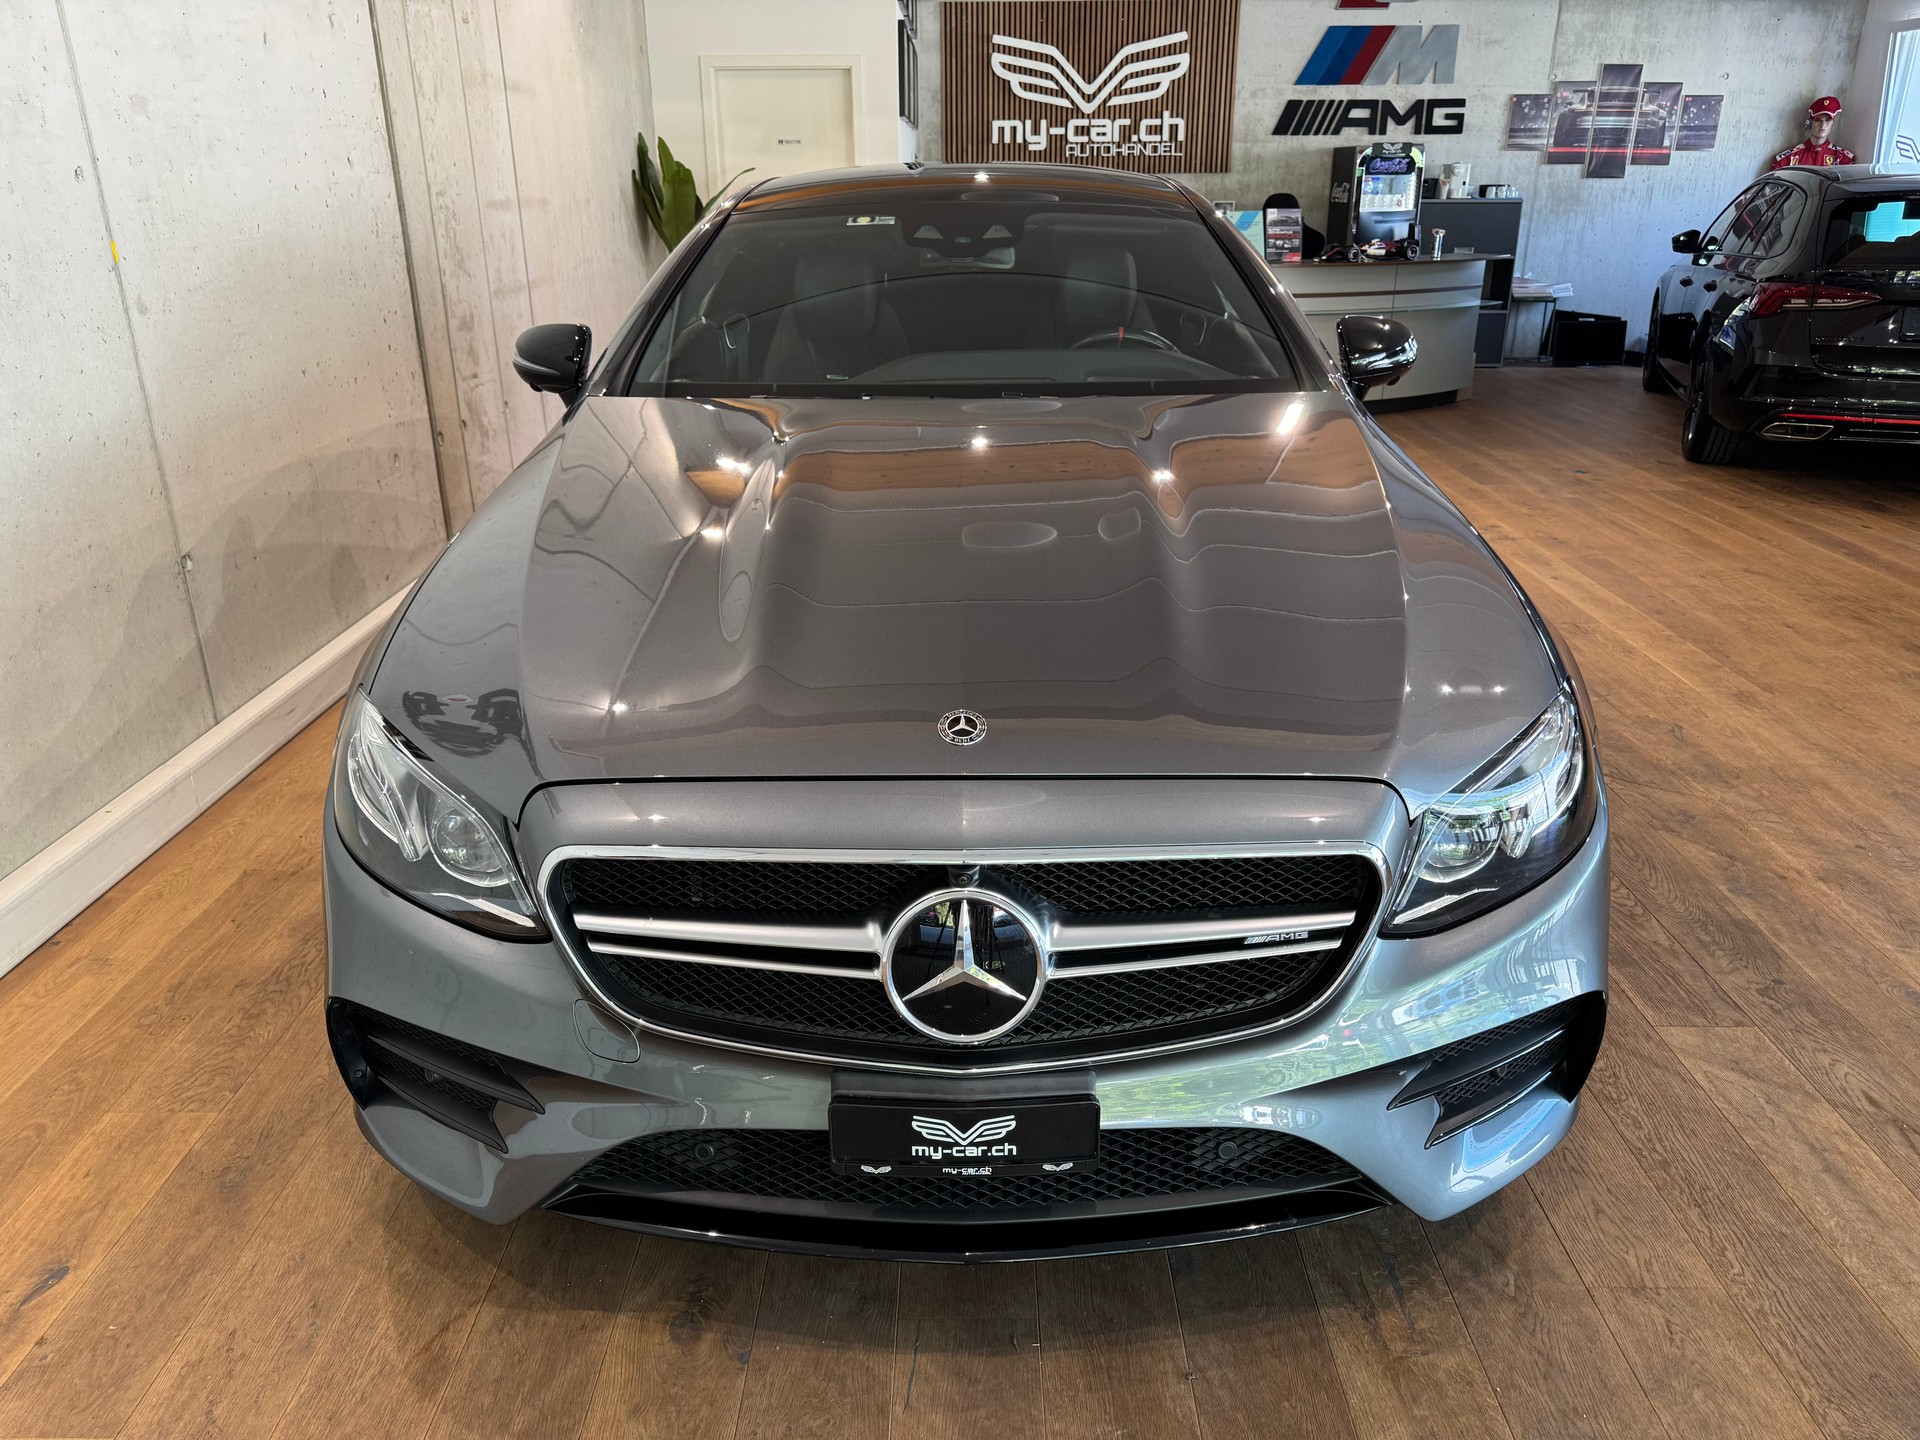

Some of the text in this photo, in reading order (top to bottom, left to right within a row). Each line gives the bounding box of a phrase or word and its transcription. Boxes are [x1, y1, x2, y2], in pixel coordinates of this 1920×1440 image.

[1331, 98, 1466, 136] AMG
[992, 110, 1184, 150] my-car.ch
[1065, 143, 1183, 158] AUTOHANDEL
[1264, 931, 1309, 943] AMG
[911, 1143, 1017, 1159] my-car.ch
[942, 1166, 992, 1175] my-car.ch
